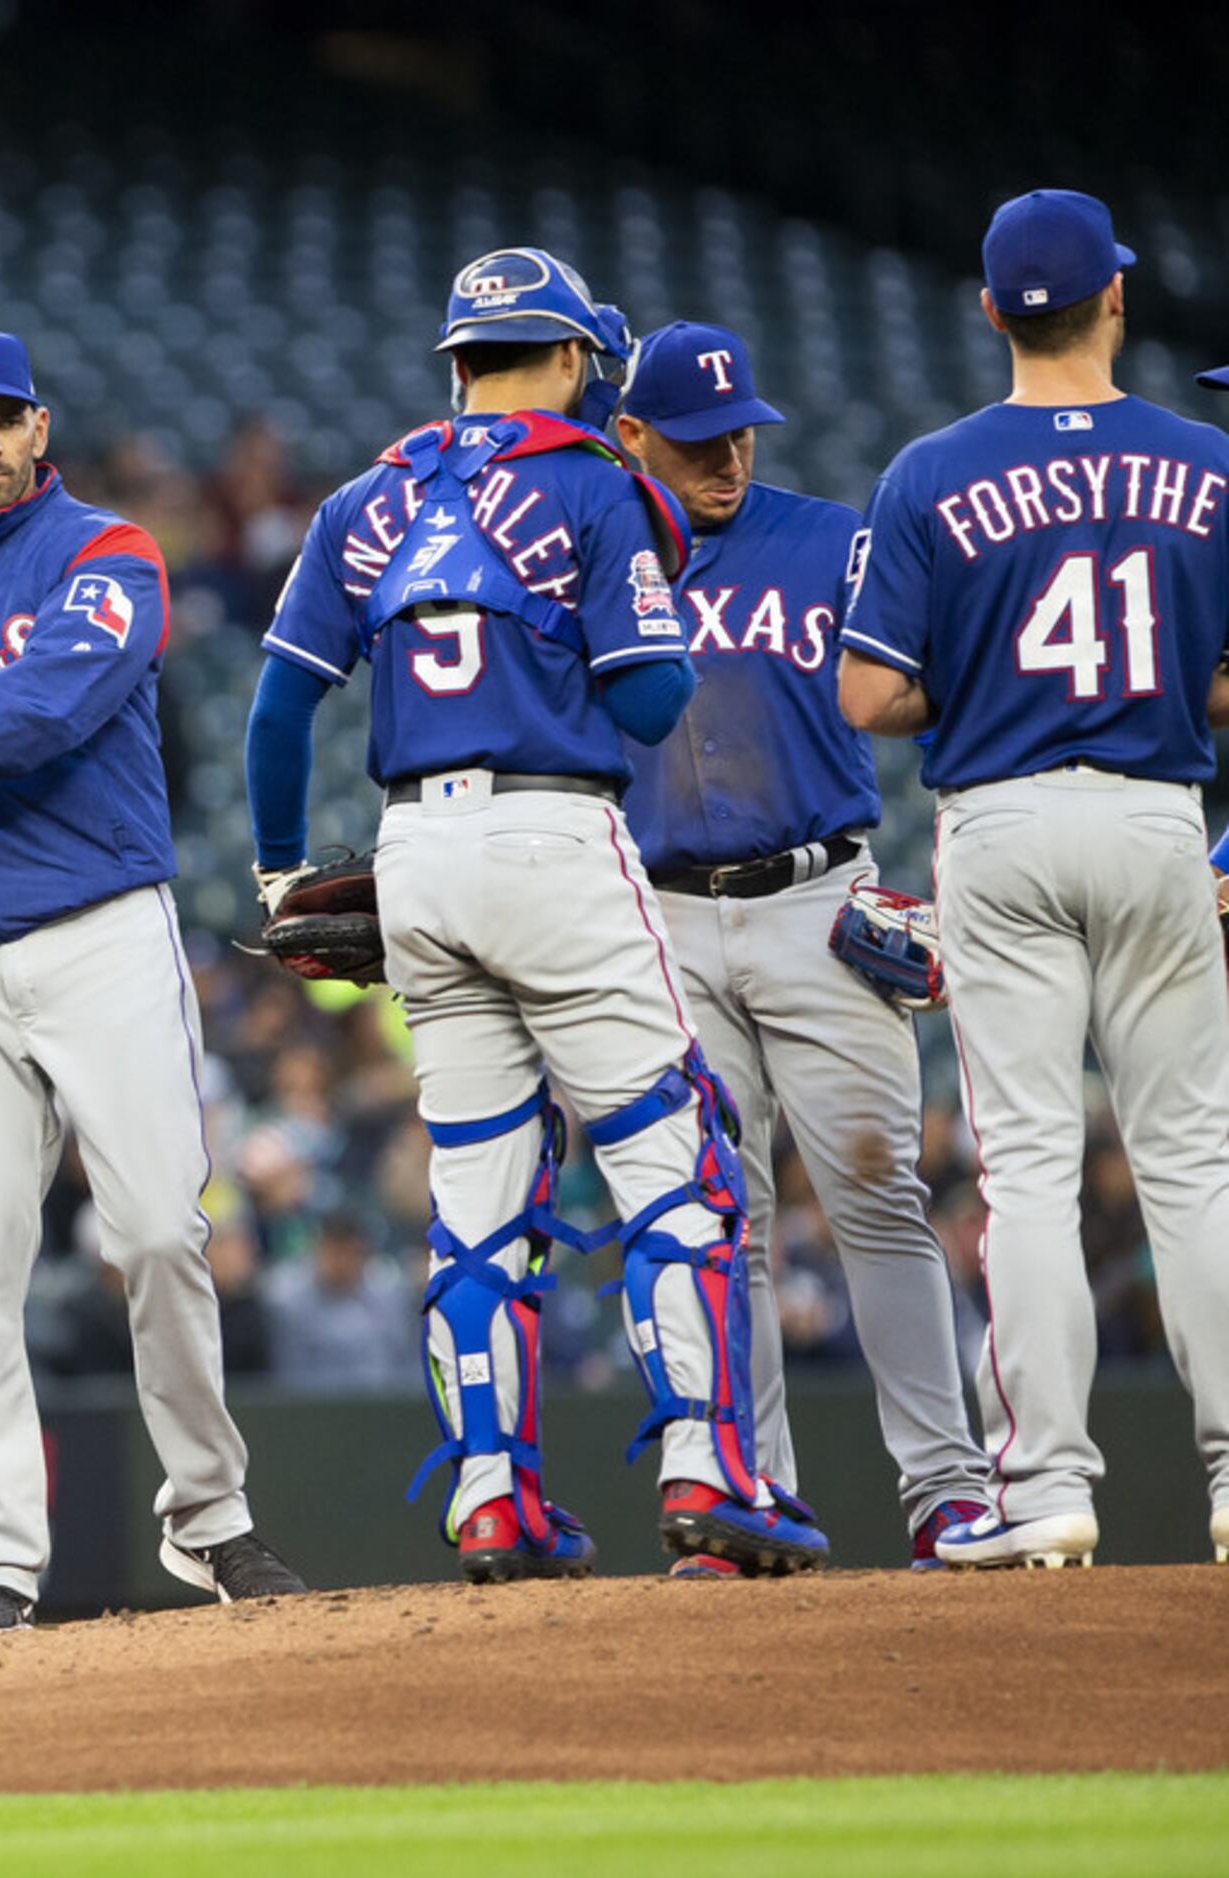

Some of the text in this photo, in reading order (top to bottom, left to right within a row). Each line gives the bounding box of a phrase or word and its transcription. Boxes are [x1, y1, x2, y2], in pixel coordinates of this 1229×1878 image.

[697, 349, 734, 392] T
[938, 453, 1228, 561] FORSYTHE
[686, 585, 836, 673] XAS
[1014, 545, 1163, 701] 41
